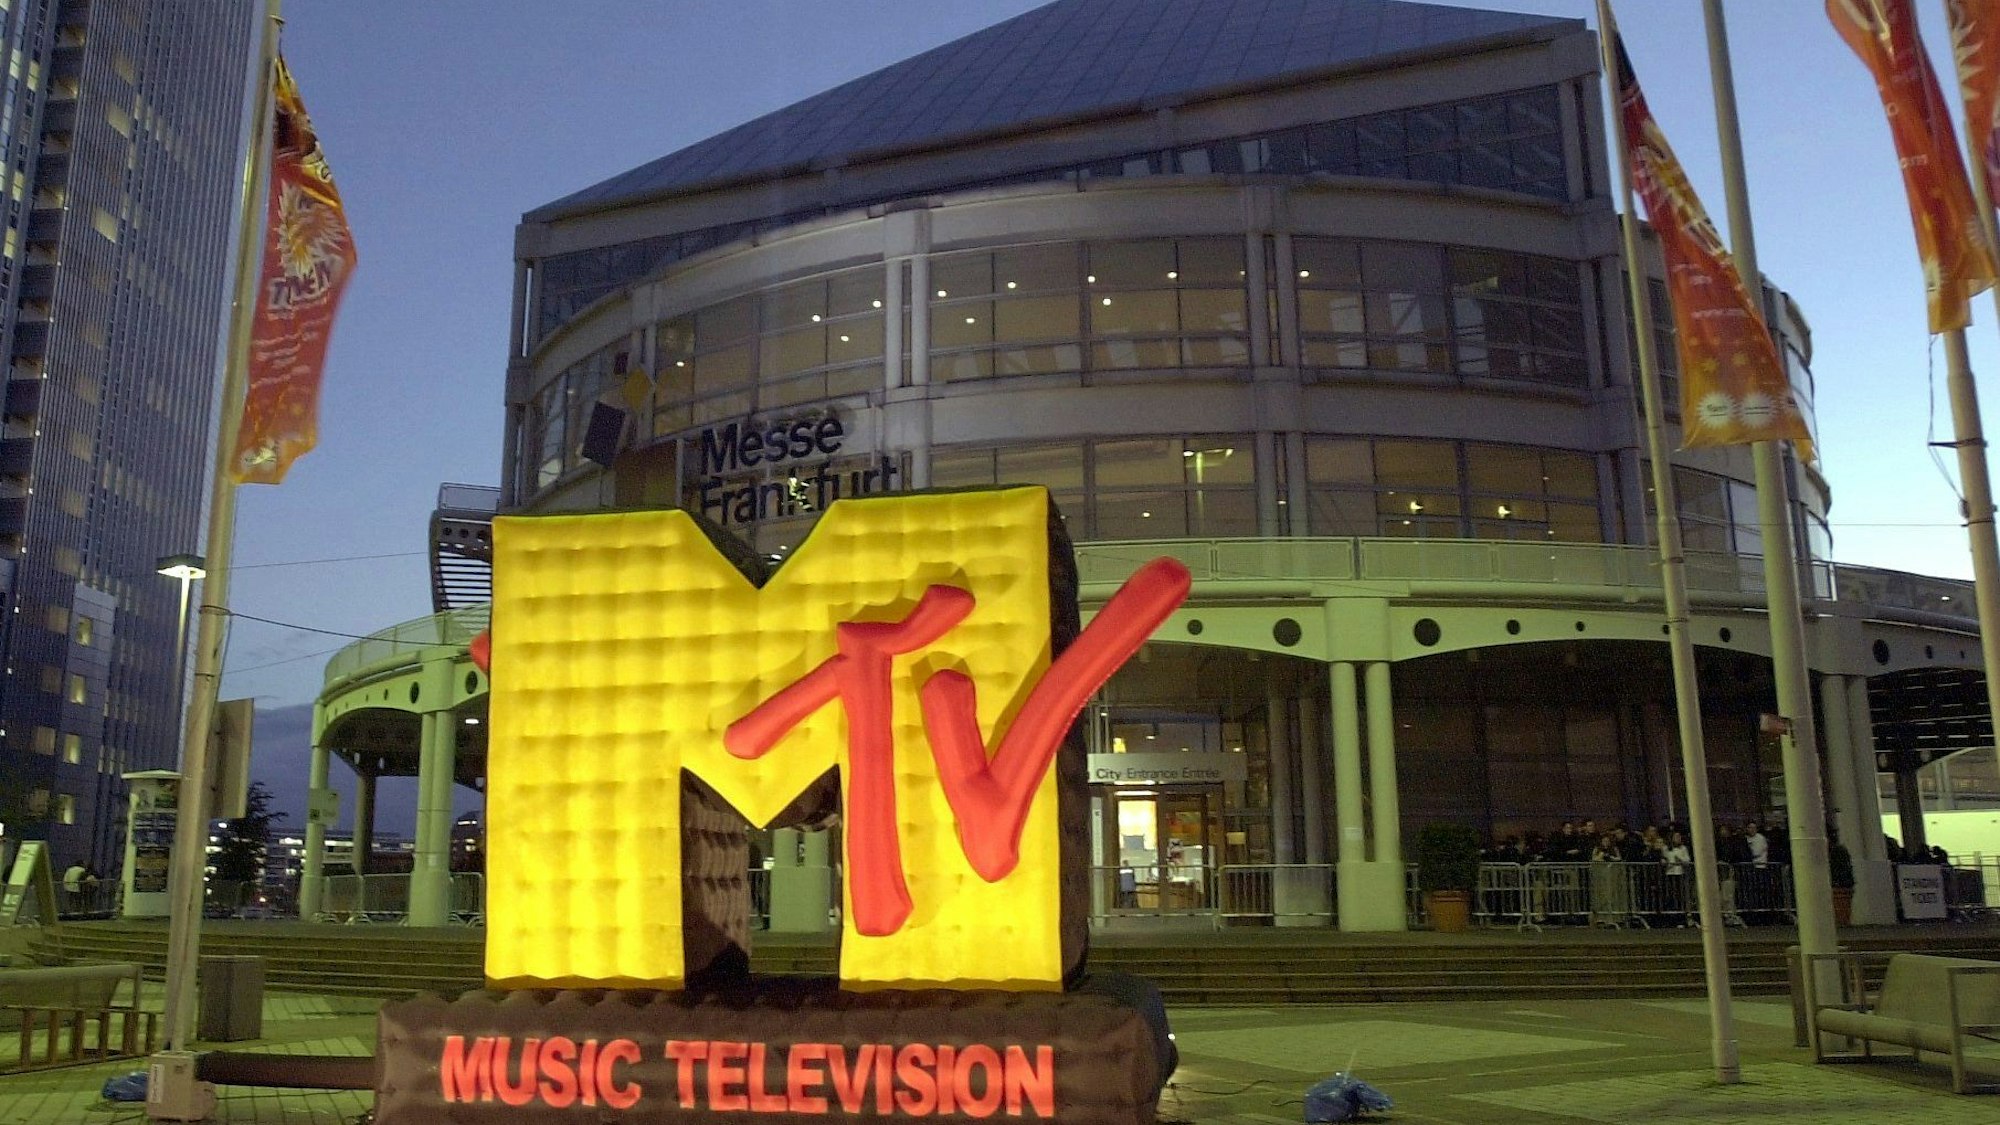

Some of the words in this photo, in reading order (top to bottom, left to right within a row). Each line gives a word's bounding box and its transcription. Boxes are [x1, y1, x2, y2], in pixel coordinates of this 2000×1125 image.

[702, 417, 844, 475] Messe
[702, 455, 897, 525] Frankfurt
[483, 484, 1191, 990] MTV
[1096, 767, 1121, 780] City
[1126, 767, 1178, 779] Entrance
[440, 1034, 642, 1110] MUSIC
[665, 1039, 1054, 1118] TELEVISION
